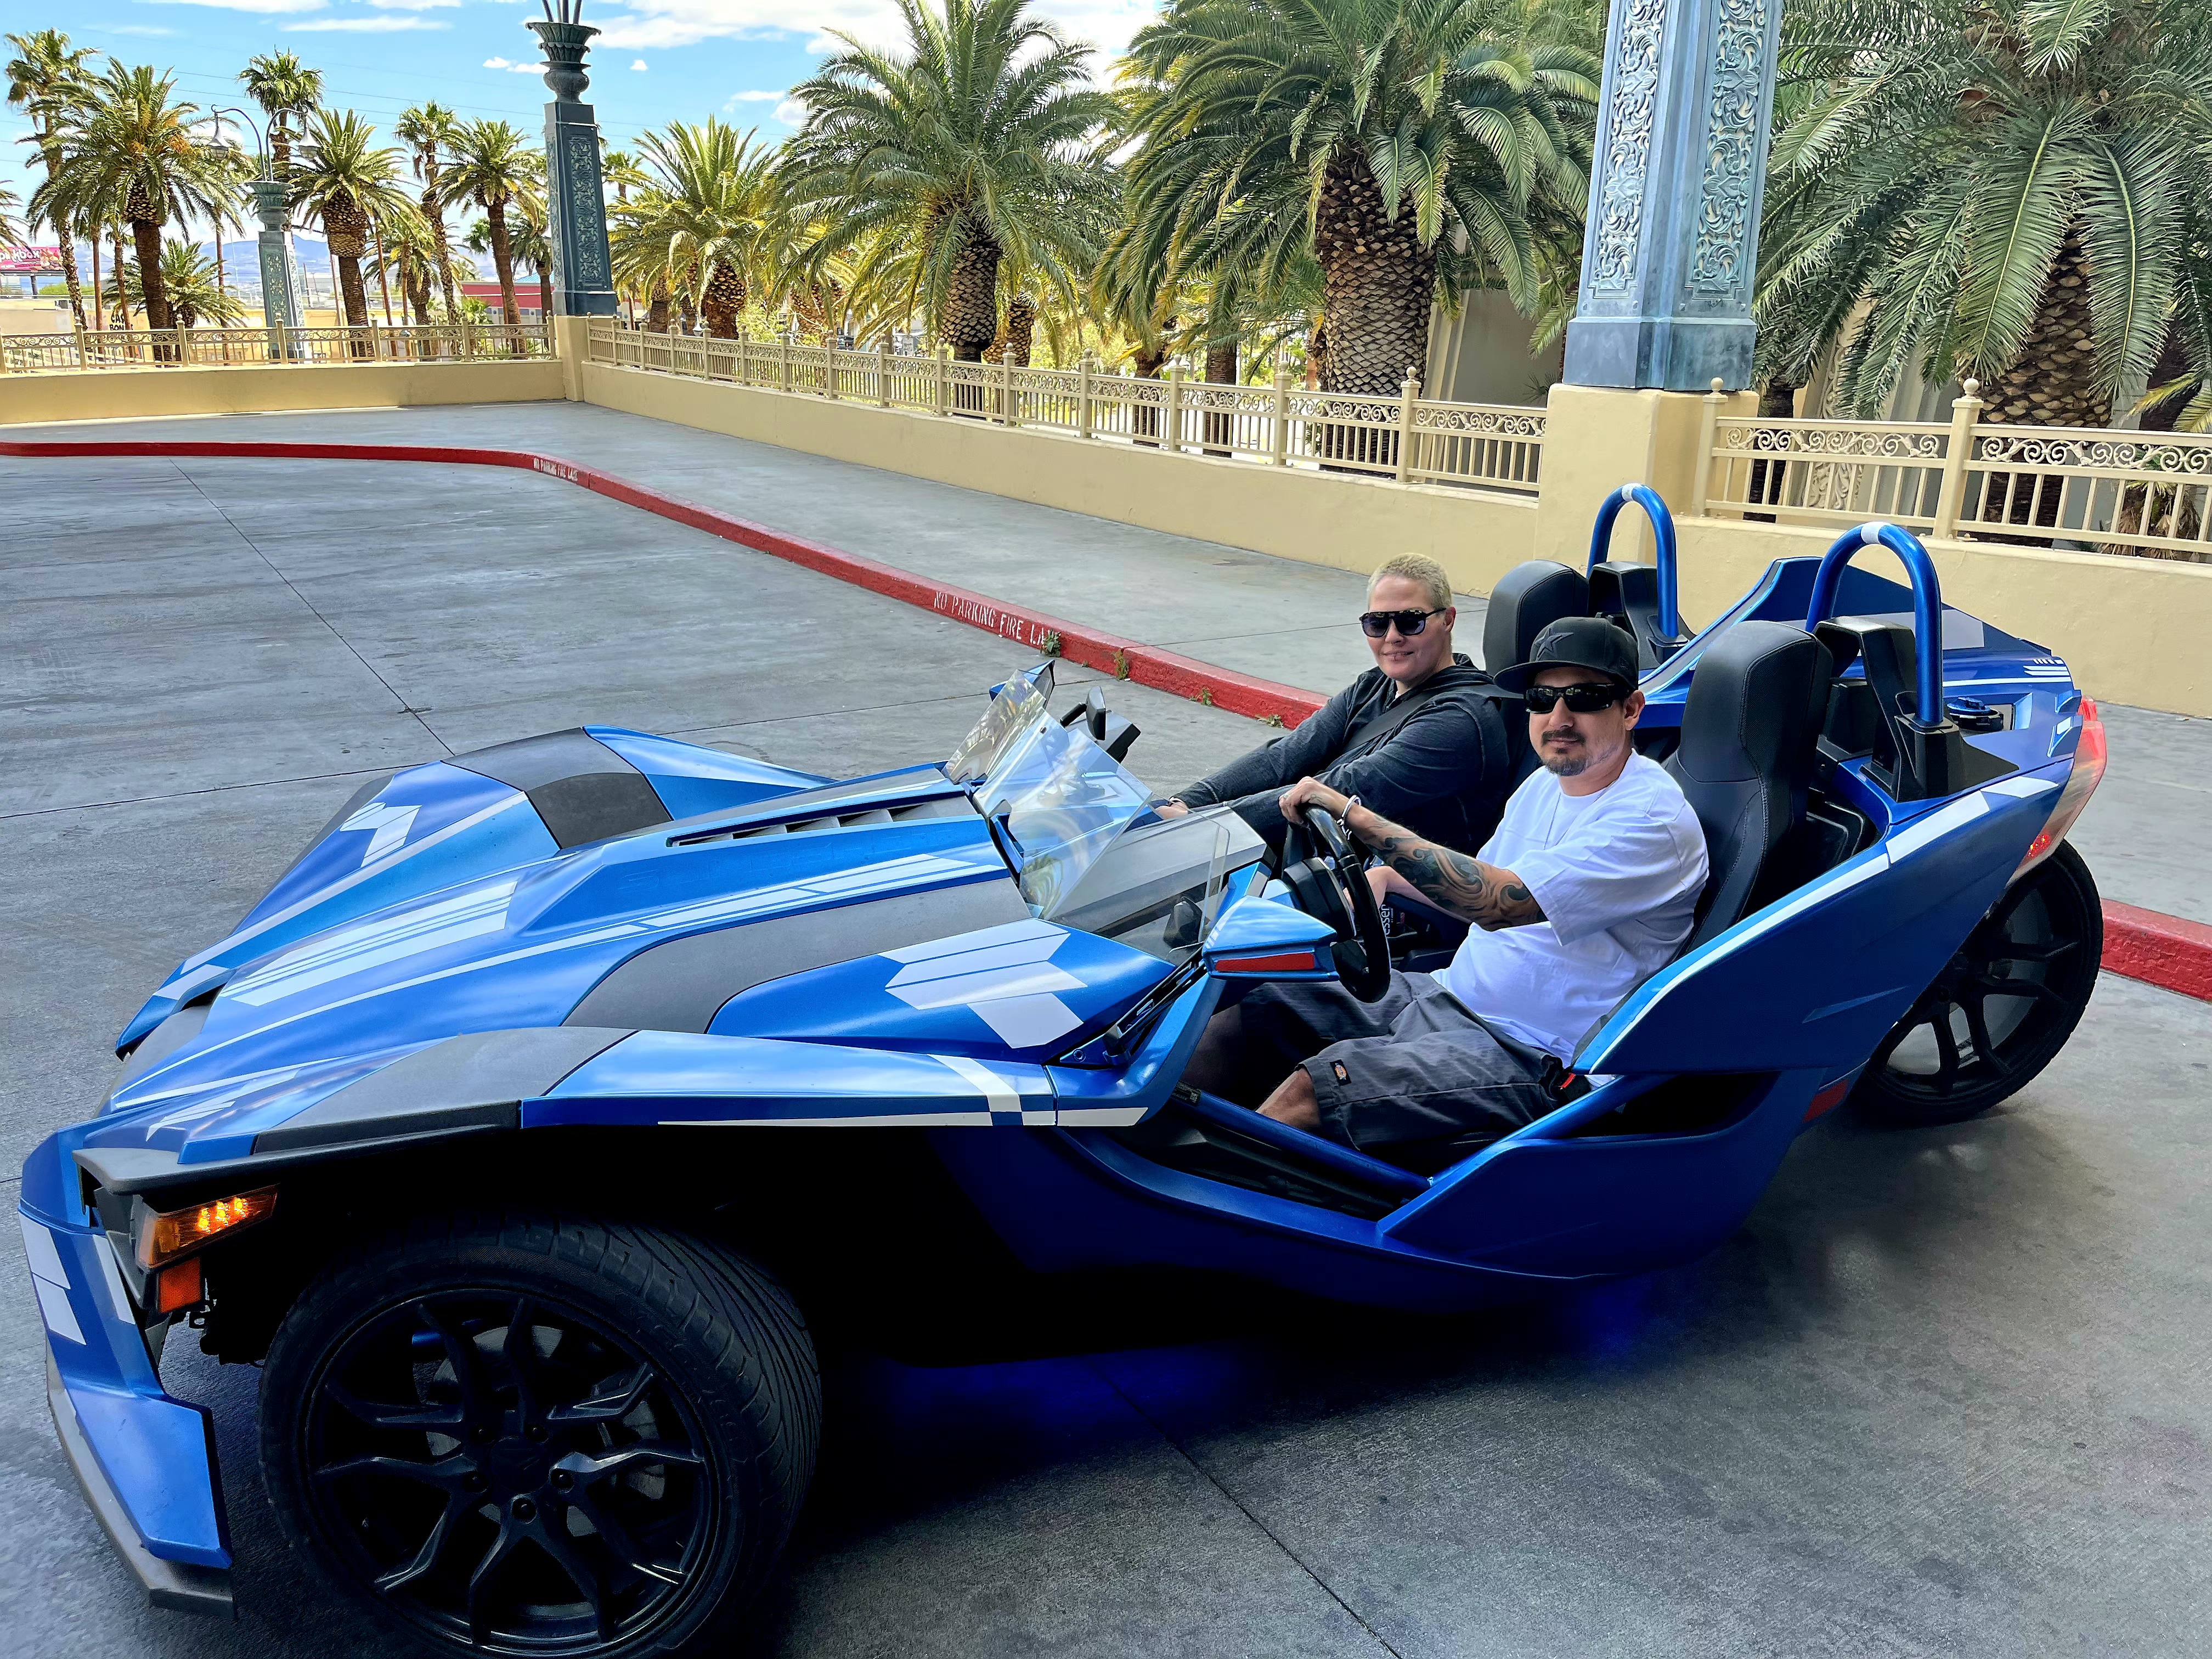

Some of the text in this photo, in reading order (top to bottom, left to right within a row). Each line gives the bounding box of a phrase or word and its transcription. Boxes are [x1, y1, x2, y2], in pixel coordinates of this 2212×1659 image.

[934, 591, 1051, 646] NO PARKING FIRE LA
